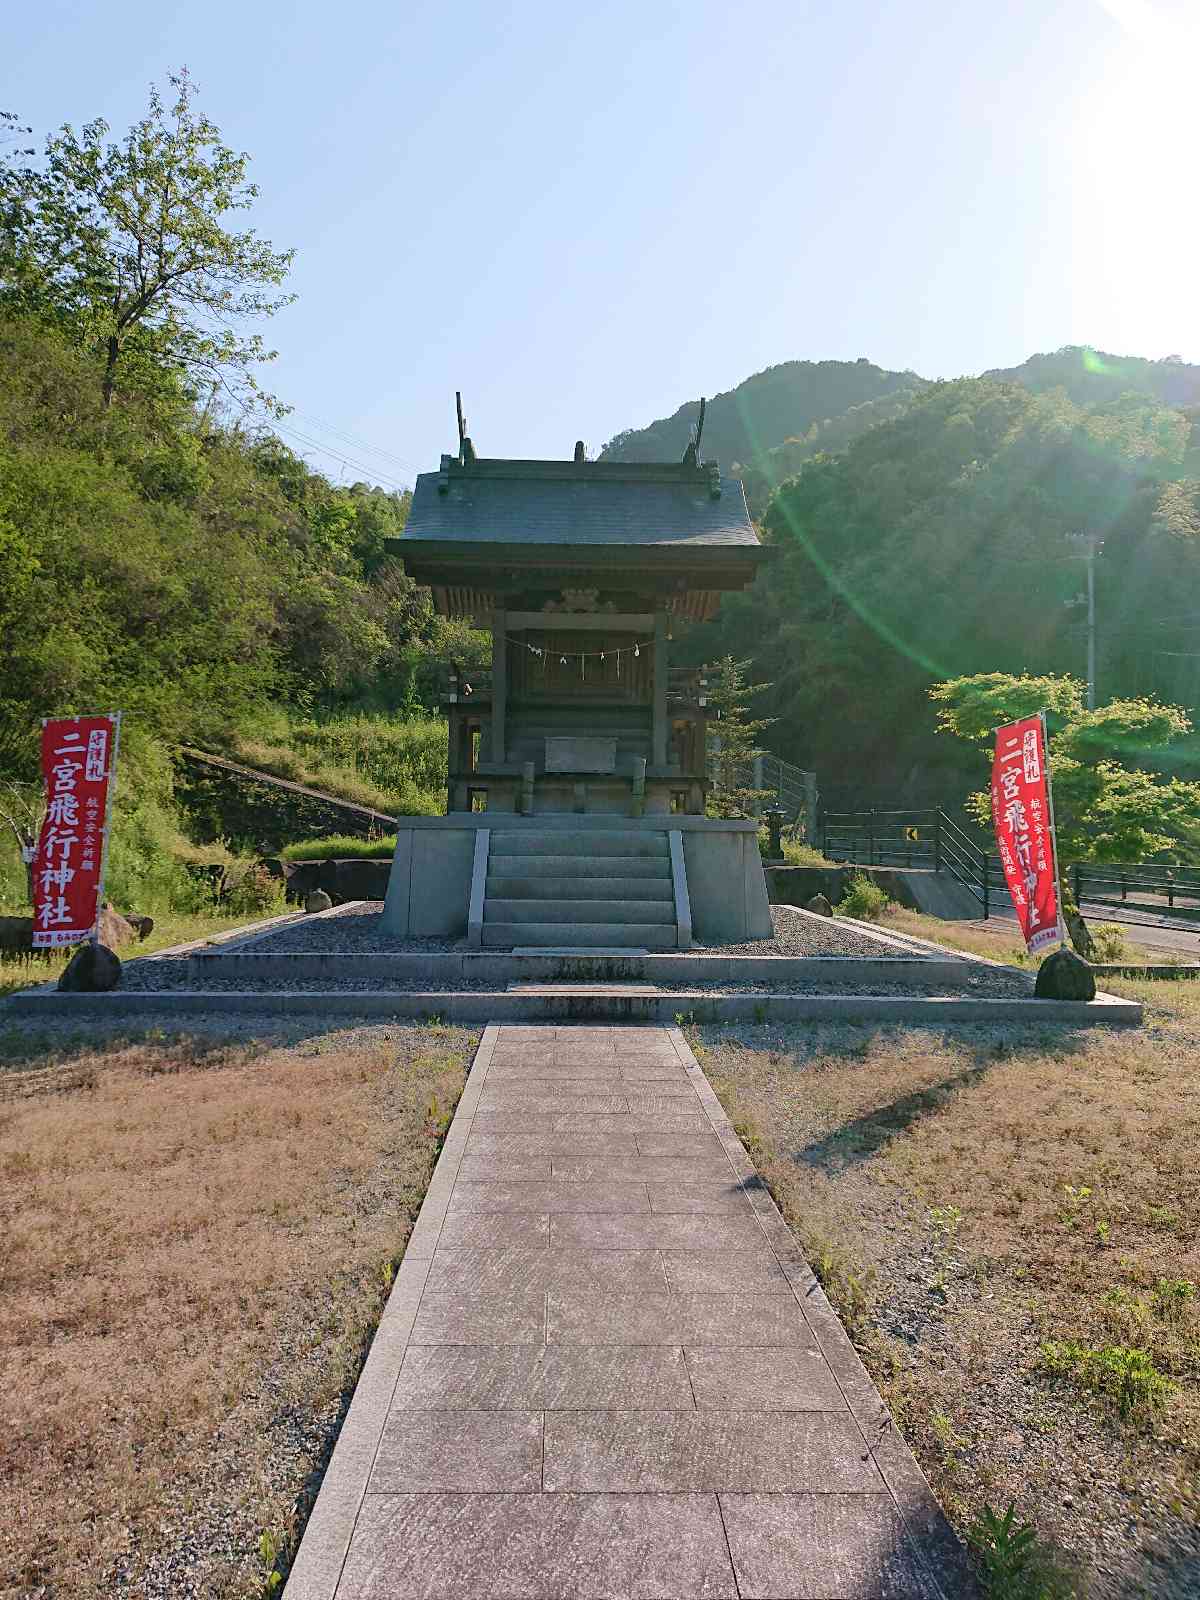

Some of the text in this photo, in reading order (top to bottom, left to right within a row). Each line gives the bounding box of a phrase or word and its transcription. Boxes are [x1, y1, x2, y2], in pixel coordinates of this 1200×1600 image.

[39, 732, 86, 929] 二宮飛行神社
